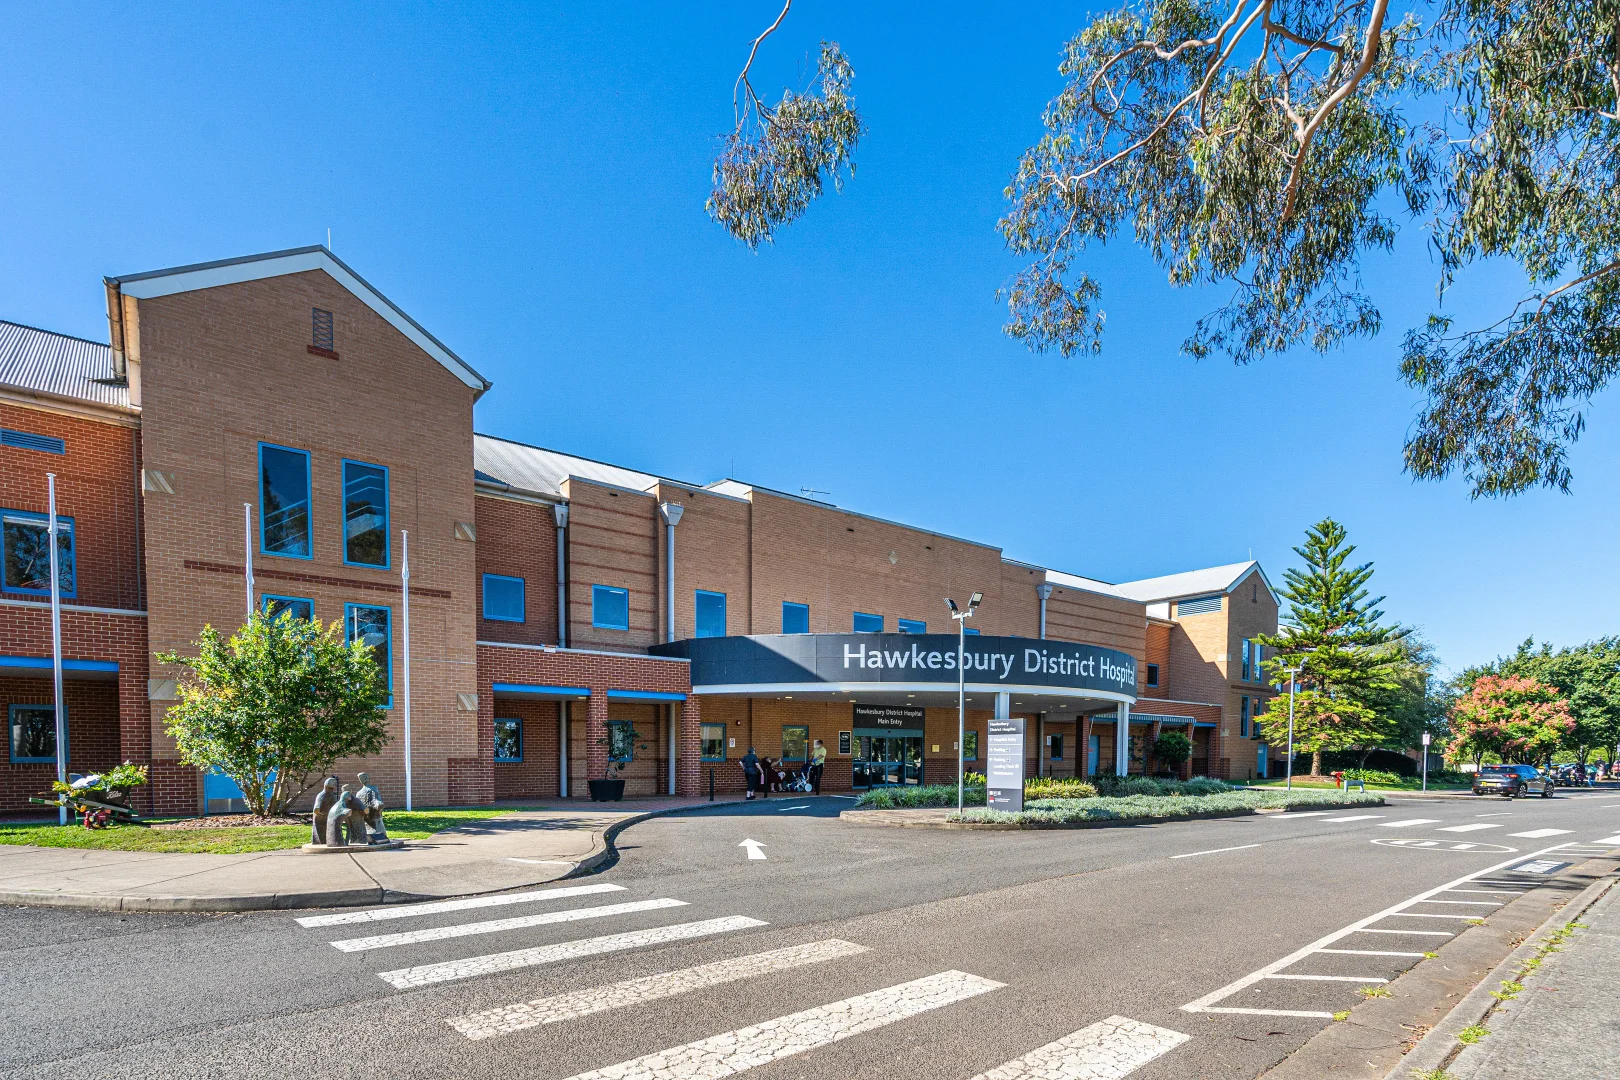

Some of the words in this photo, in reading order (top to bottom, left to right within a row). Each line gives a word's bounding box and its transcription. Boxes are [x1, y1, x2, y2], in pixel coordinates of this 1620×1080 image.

[843, 643, 1015, 679] Hawkesbury
[1024, 647, 1095, 678] District
[1100, 656, 1136, 688] Hospital
[856, 708, 885, 716] Hawkesbury
[890, 718, 903, 726] Entry
